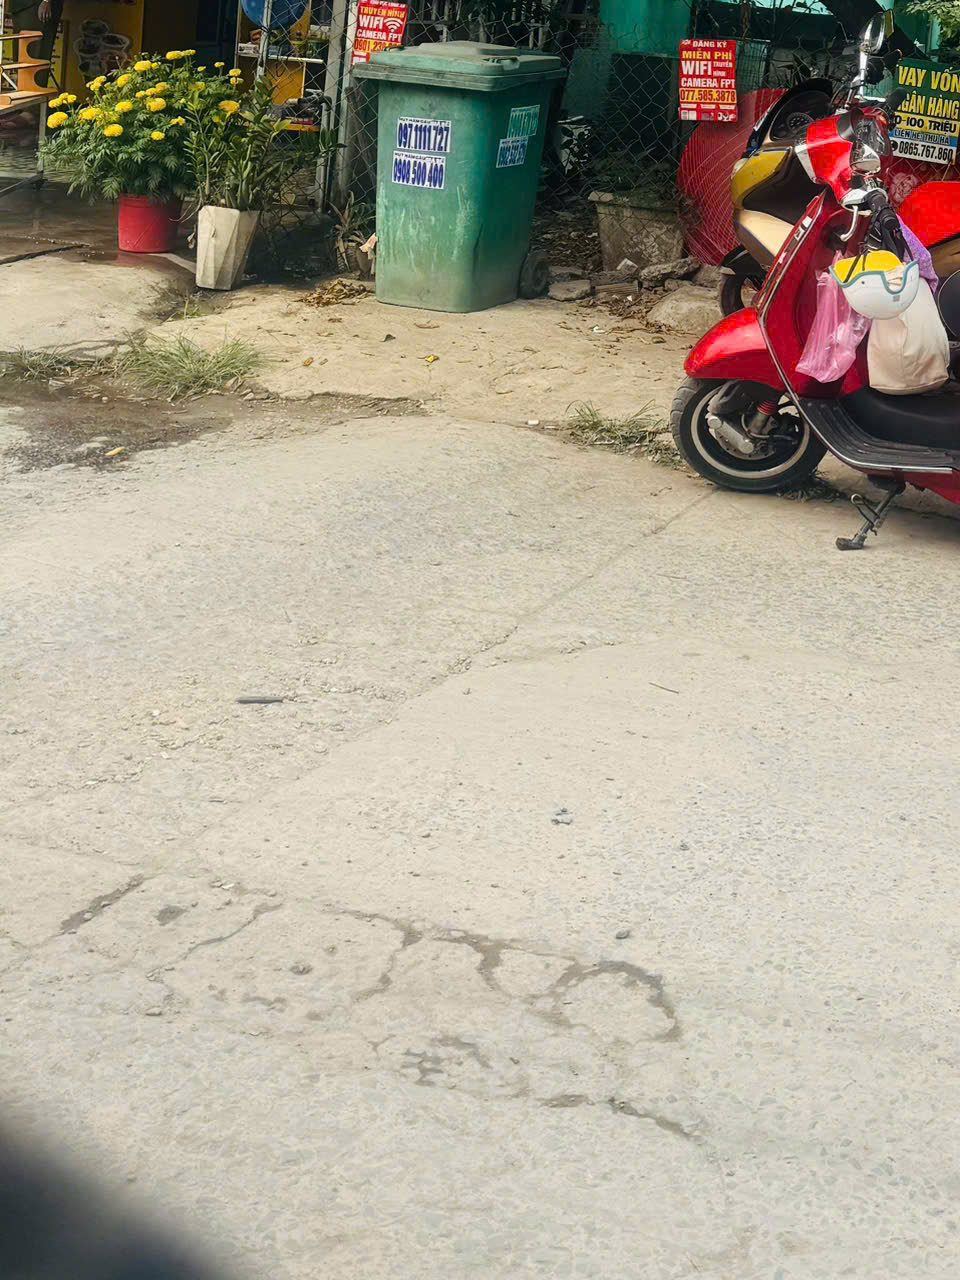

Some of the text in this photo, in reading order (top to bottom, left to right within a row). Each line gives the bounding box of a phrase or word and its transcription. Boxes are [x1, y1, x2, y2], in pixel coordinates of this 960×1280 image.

[359, 14, 385, 30] WIFI
[356, 29, 403, 42] CAMERA FPT
[682, 48, 733, 60] MIỄN PHÍ
[681, 60, 712, 76] WIFI
[681, 78, 736, 89] CAMERA FPT
[898, 65, 927, 88] VAY
[680, 89, 736, 102] 077.585.3878
[927, 94, 960, 120] HÀNG
[927, 120, 957, 135] TRIỆU
[398, 122, 450, 152] 097.1111.727
[899, 140, 953, 161] 0865.767.860
[393, 157, 444, 188] 0908.500.400
